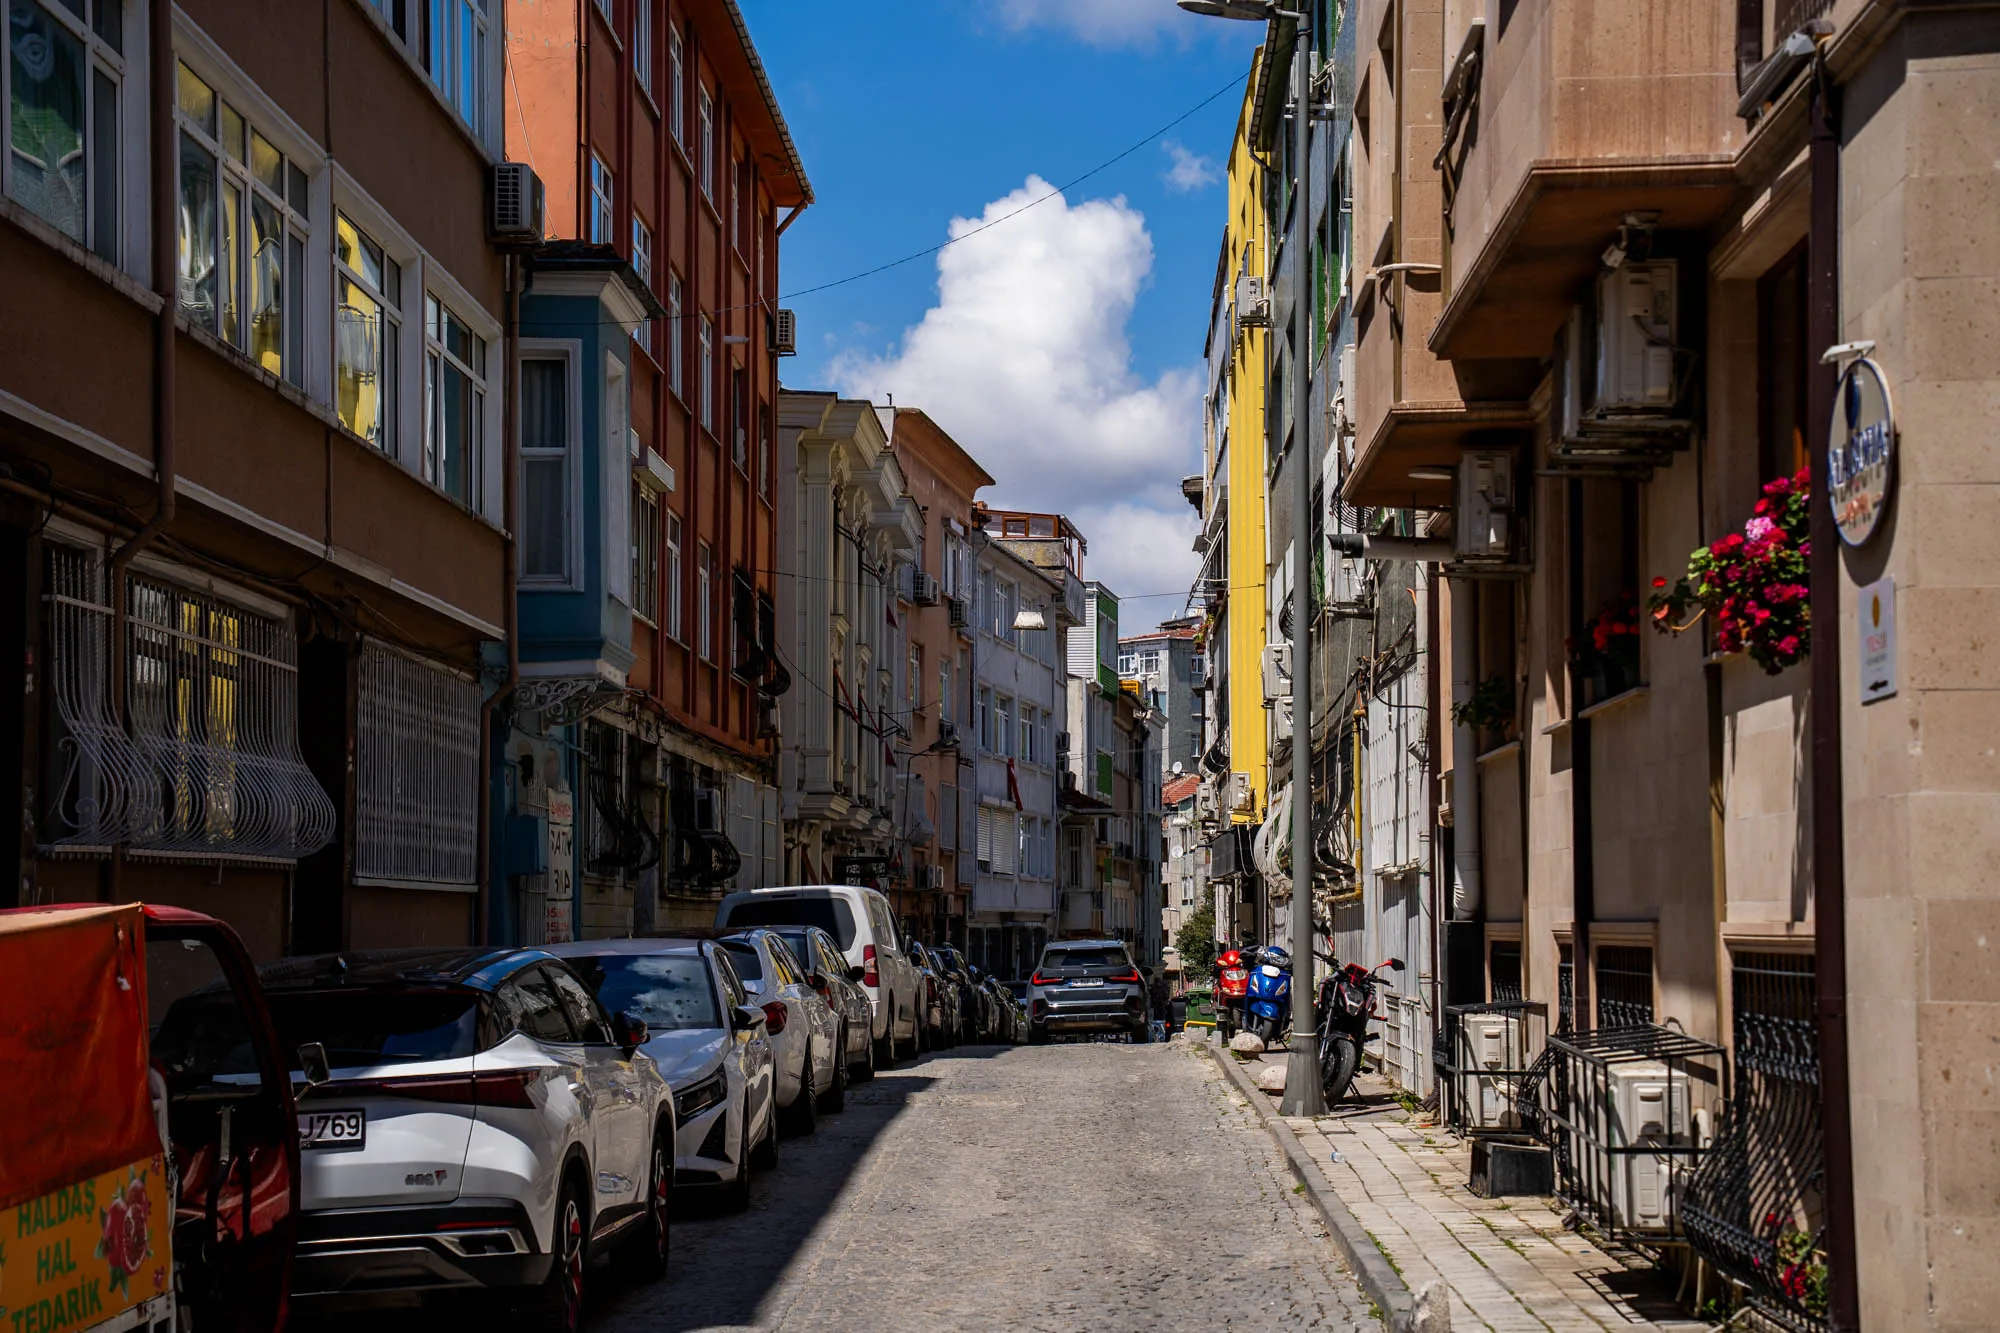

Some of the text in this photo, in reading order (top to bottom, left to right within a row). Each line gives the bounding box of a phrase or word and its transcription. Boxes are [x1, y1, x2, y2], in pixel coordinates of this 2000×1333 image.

[18, 1179, 97, 1239] HALDAŞ
[37, 1236, 77, 1286] HAL
[11, 1274, 103, 1333] TEDARİK
